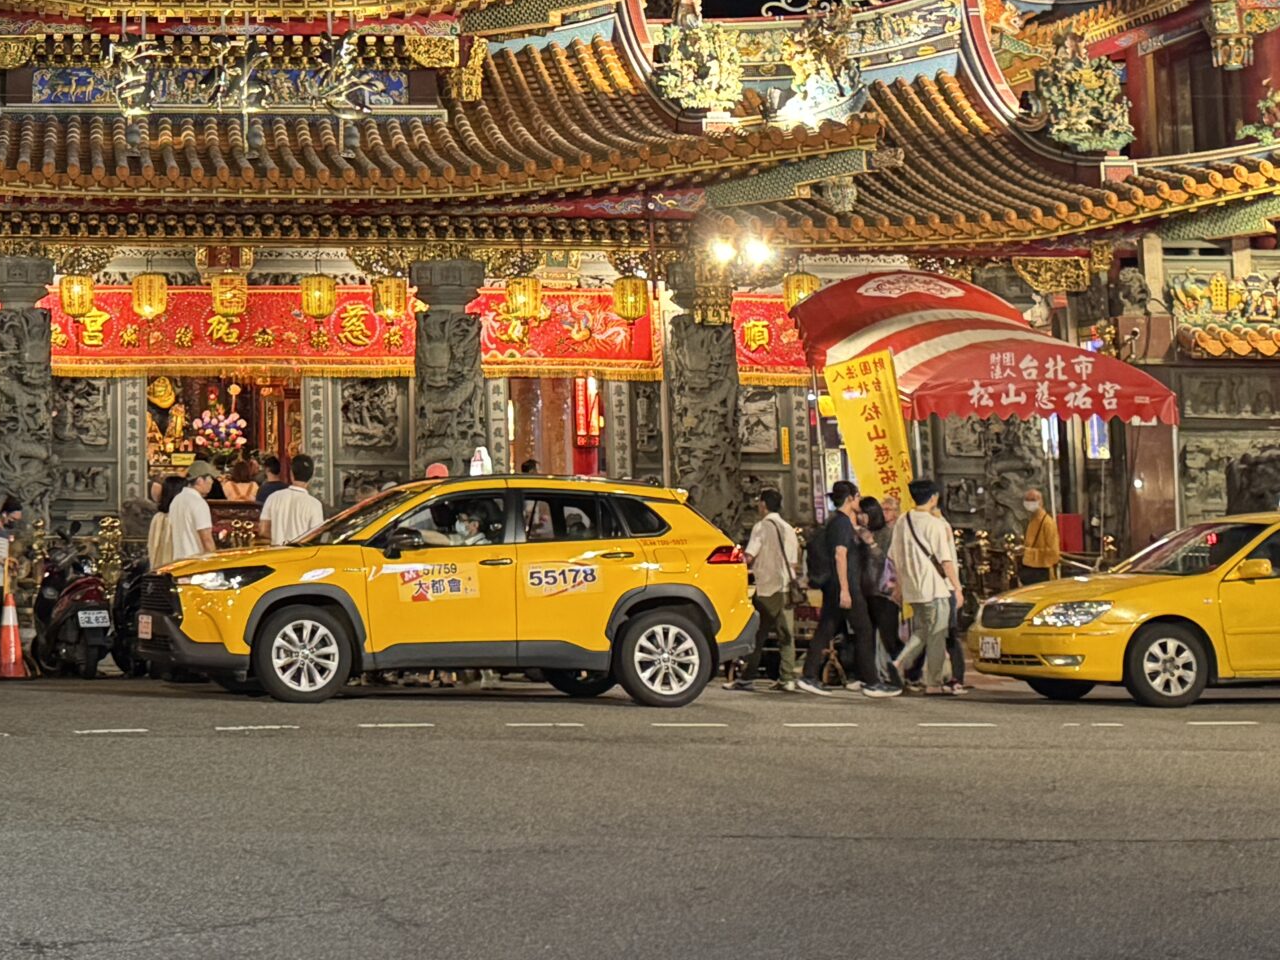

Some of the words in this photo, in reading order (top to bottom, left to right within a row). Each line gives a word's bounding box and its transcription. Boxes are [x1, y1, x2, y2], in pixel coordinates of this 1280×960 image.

[741, 320, 771, 354] 順
[1019, 354, 1095, 381] 台北市
[968, 380, 1122, 410] 松山慈祐宮
[413, 578, 462, 594] 大都會
[529, 568, 597, 586] 55178
